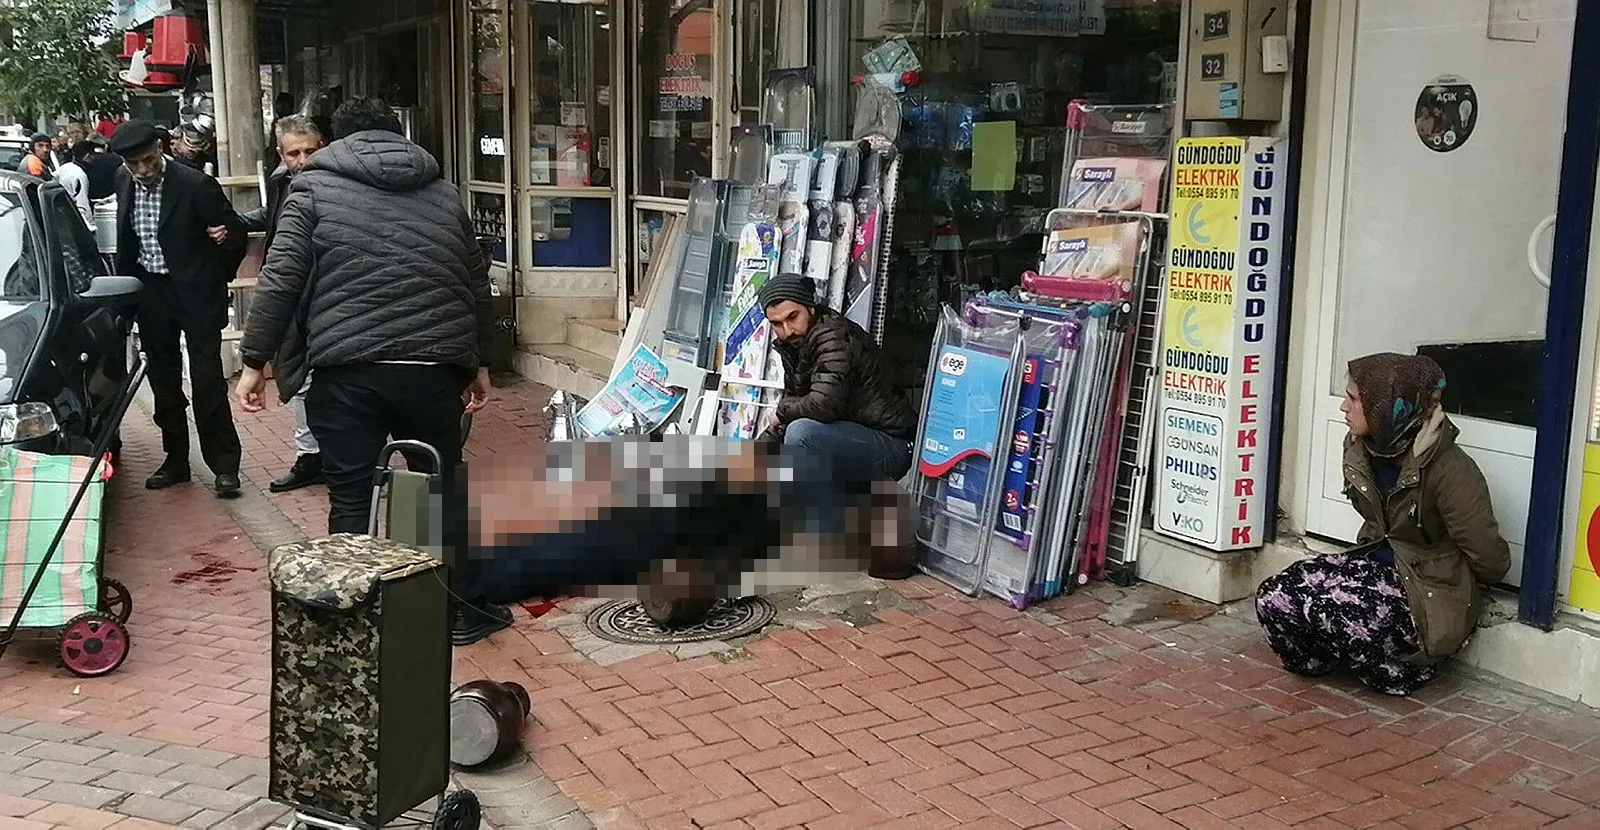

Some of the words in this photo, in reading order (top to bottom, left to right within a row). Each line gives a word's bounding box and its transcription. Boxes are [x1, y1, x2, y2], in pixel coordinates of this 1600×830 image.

[1208, 17, 1224, 33] 34
[1205, 59, 1221, 75] 32
[1436, 92, 1457, 103] AÇIK
[1178, 142, 1242, 165] GÜNDOĞDU
[1220, 188, 1228, 199] 91
[1230, 188, 1239, 199] 70
[1172, 244, 1235, 271] GÜNDOĞDU
[1213, 293, 1222, 304] 91
[1223, 294, 1233, 305] 70
[949, 358, 964, 371] ege
[1166, 346, 1229, 375] GÜNDOĞDU
[1168, 415, 1218, 436] SIEMENS
[1165, 455, 1217, 481] PHILIPS
